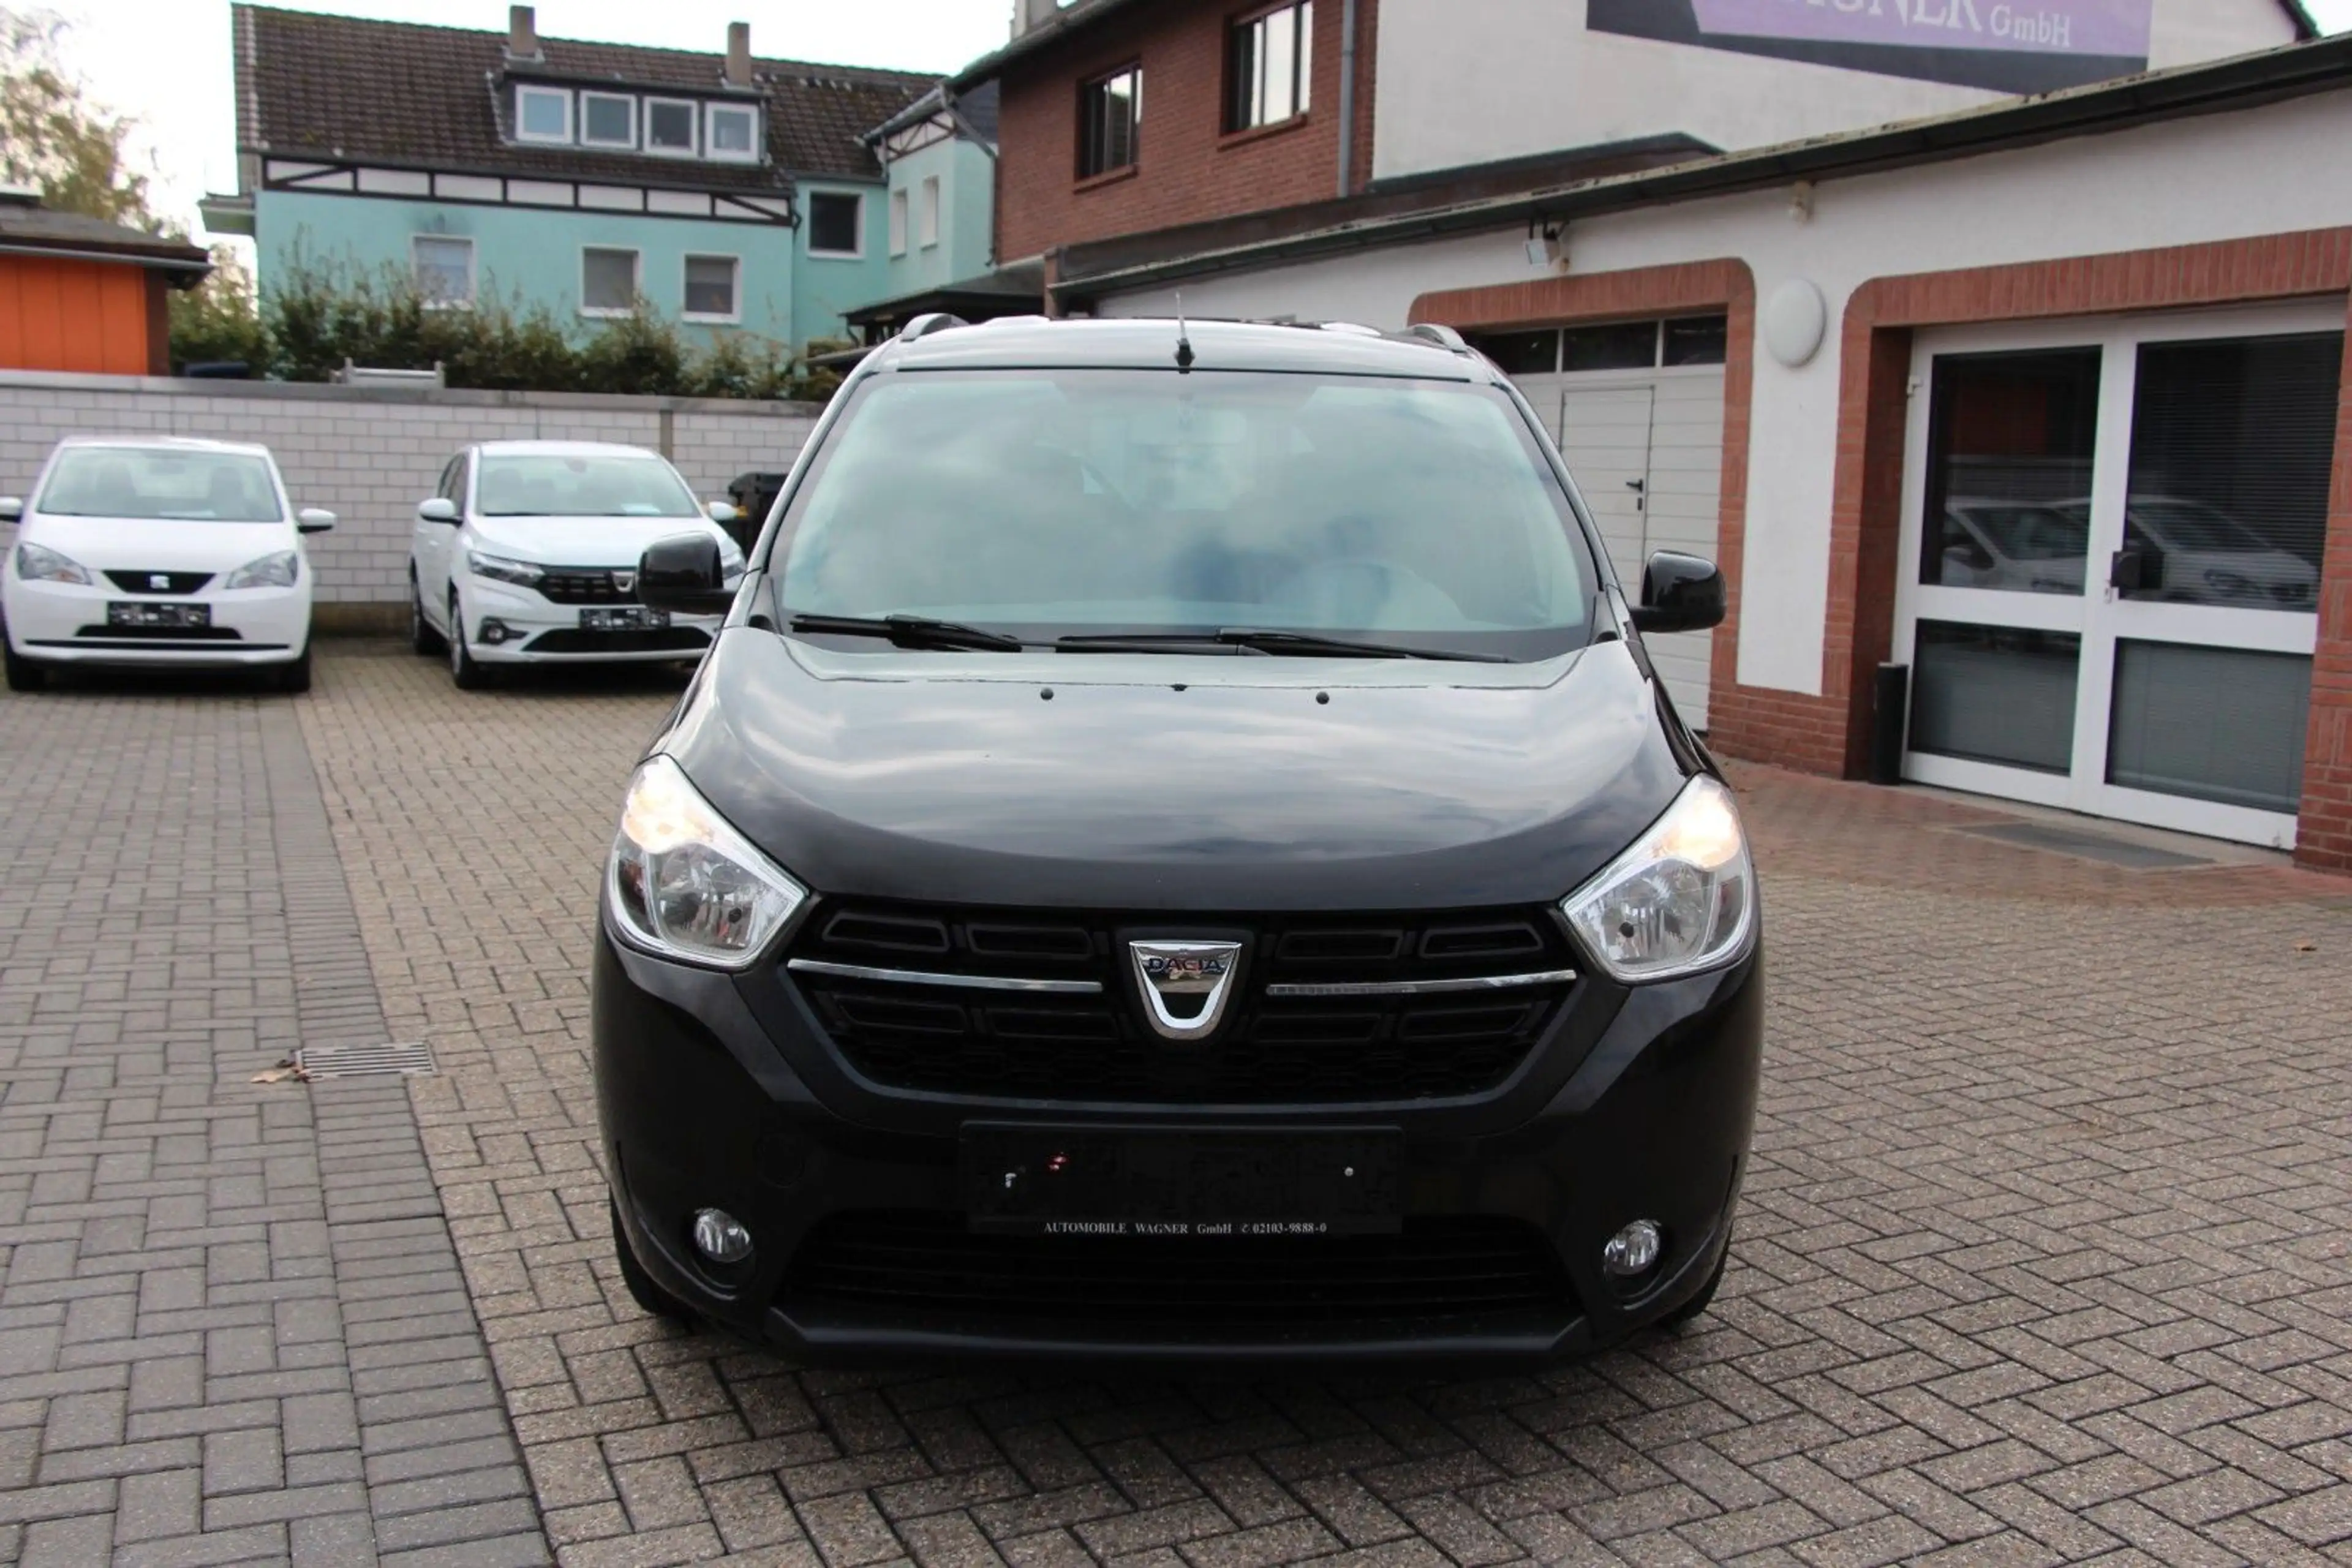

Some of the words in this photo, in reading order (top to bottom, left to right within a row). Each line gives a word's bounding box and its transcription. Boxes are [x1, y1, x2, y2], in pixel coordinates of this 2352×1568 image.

[1989, 4, 2071, 48] GmbH
[1148, 957, 1223, 972] DACIA
[1044, 1222, 1127, 1234] AUTOMOBILE
[1135, 1223, 1188, 1234] WAGNER
[1197, 1223, 1232, 1234] GmbH
